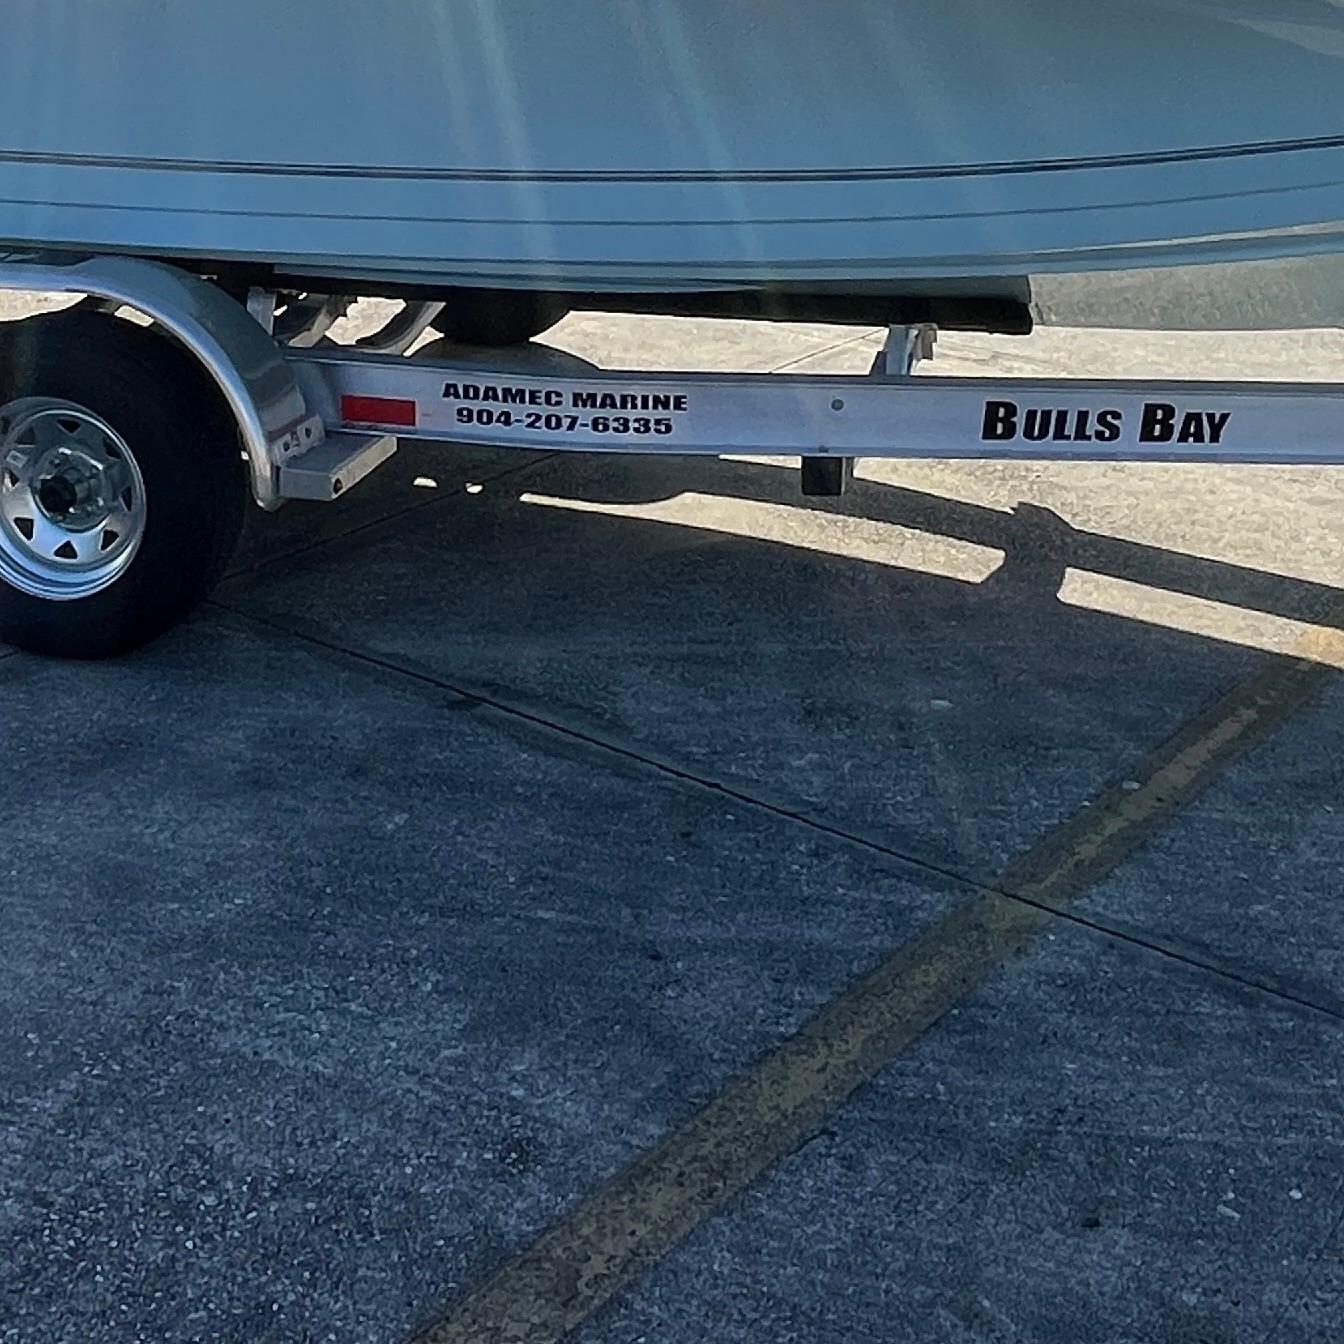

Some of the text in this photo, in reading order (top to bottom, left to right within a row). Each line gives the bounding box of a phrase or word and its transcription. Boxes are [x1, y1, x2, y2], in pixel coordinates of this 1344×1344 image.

[442, 382, 688, 412] ADAMEC MARINE
[455, 407, 674, 435] 904-207-6335
[981, 400, 1231, 444] BULLS BAY
